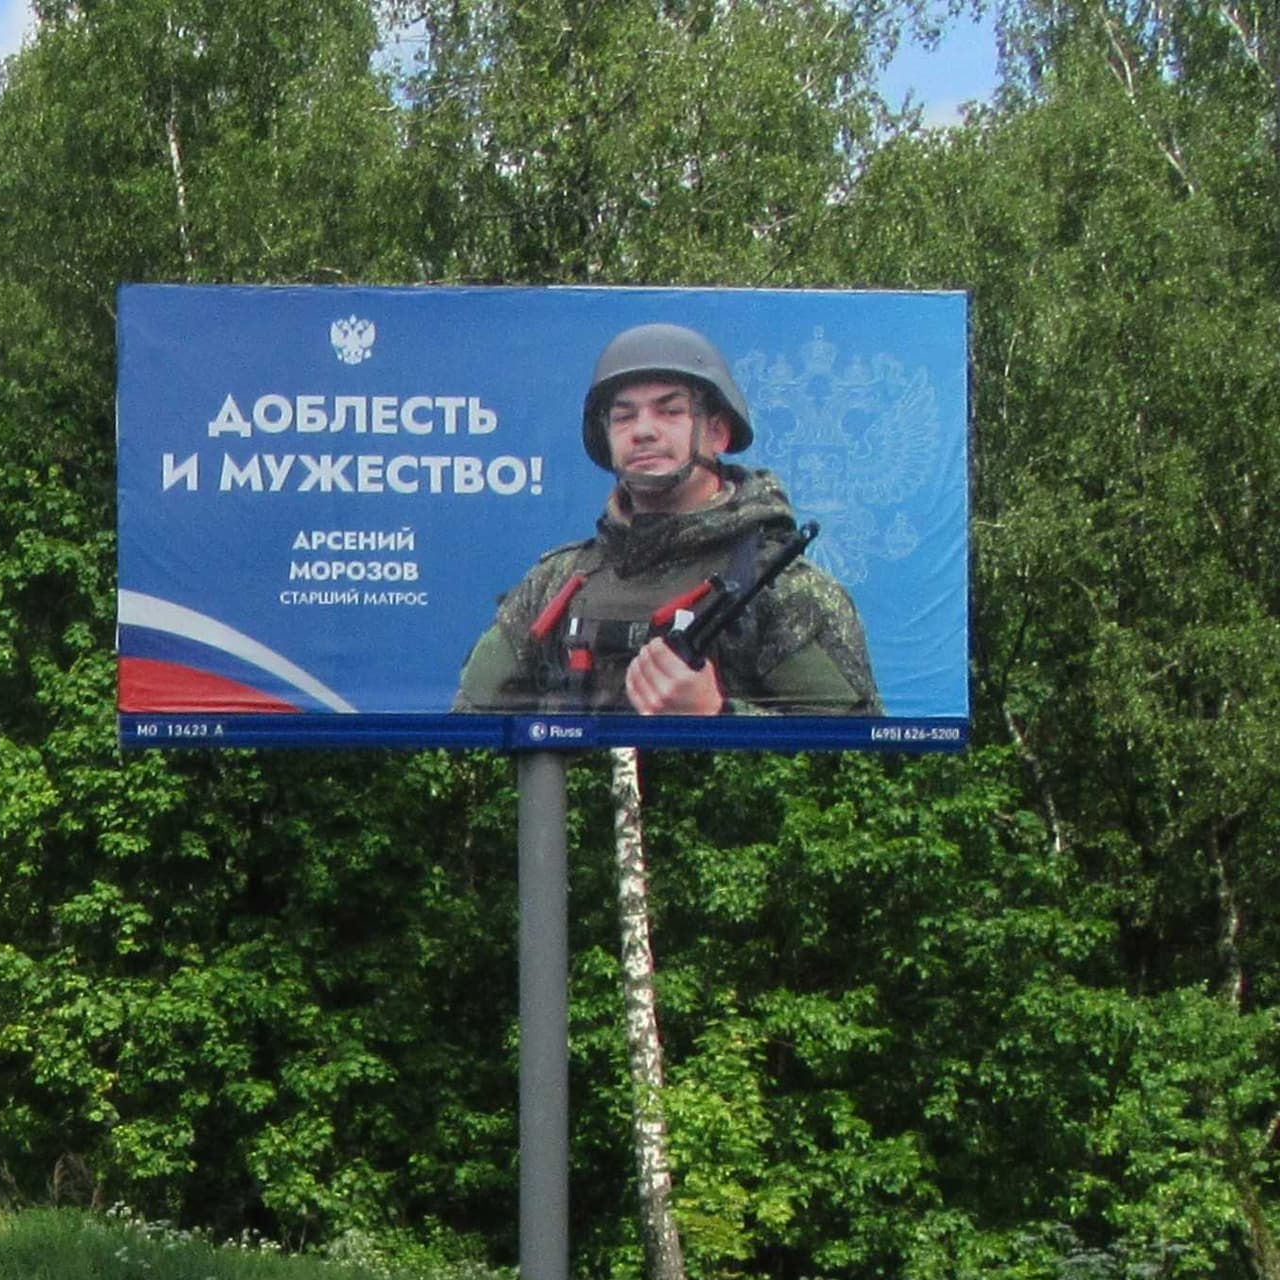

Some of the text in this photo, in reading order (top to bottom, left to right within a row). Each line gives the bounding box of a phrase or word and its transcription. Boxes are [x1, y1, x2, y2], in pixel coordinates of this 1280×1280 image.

[208, 393, 497, 437] ДОБЛЕСТЬ
[162, 453, 543, 495] И МУЖЕСТВО!
[292, 527, 415, 551] АРСЕНИЙ
[289, 561, 420, 581] МОРОЗОВ
[280, 588, 428, 606] СТАРШИЙ МАТРОС
[550, 725, 583, 738] Russ
[871, 727, 960, 740] (495) 626-5200
